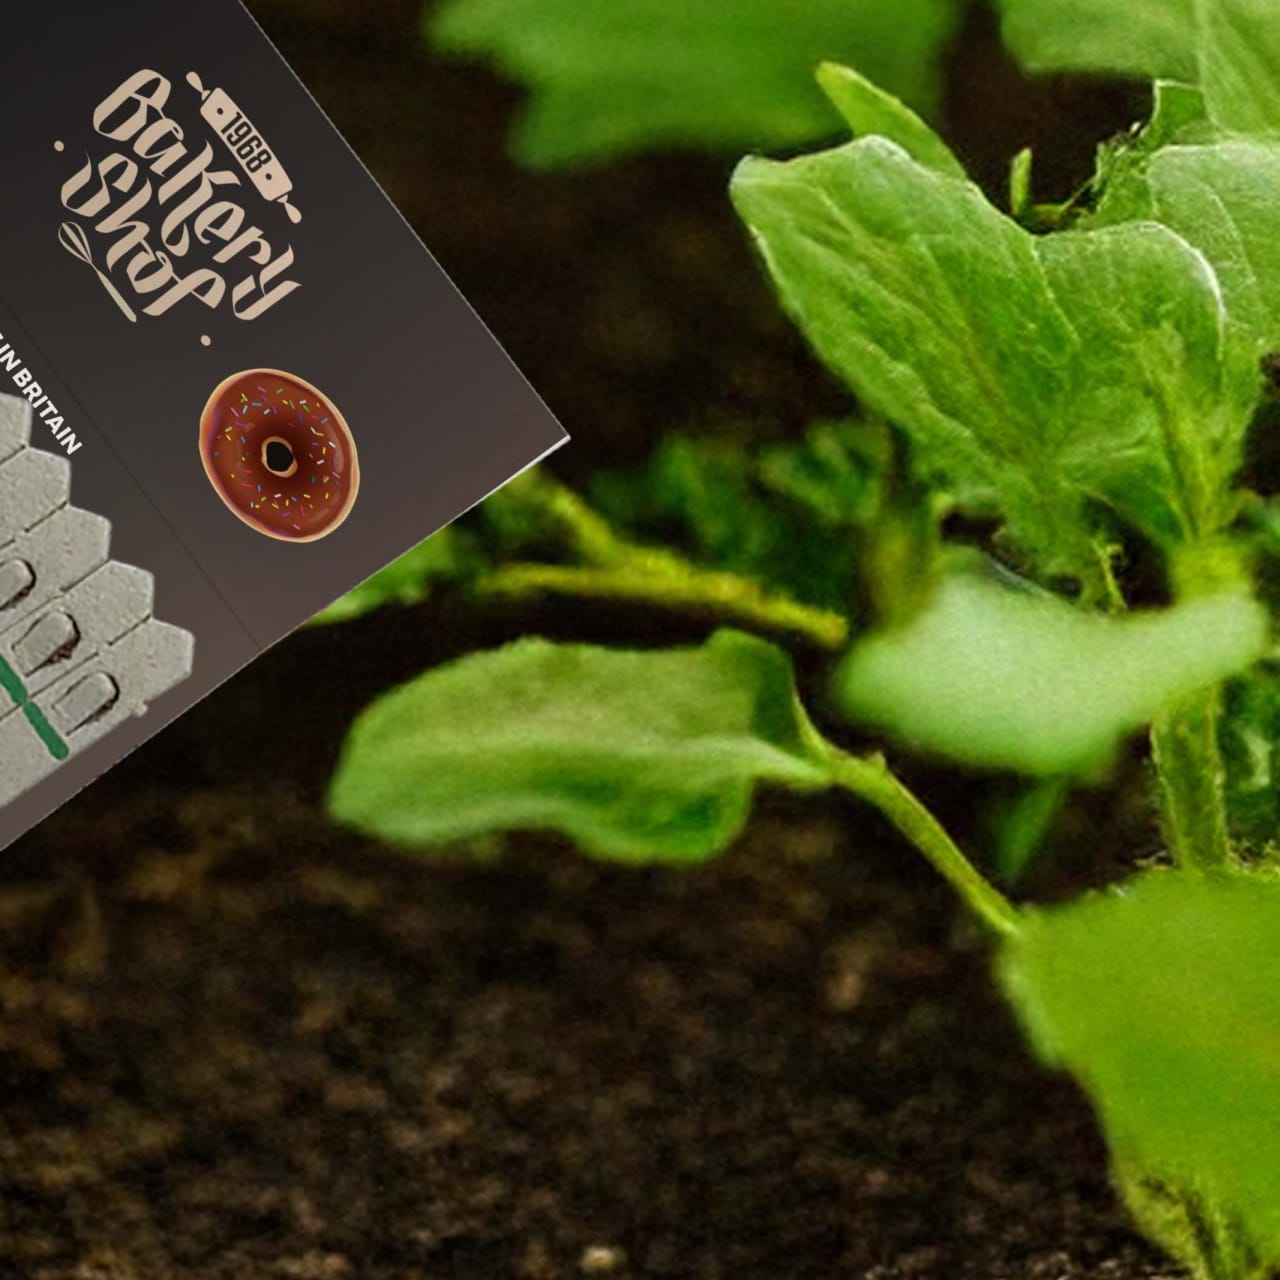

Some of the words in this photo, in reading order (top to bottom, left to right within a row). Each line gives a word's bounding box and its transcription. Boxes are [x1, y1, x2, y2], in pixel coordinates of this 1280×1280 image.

[221, 111, 272, 173] 1968
[60, 150, 226, 317] Shop
[11, 368, 83, 455] BRITAIN
